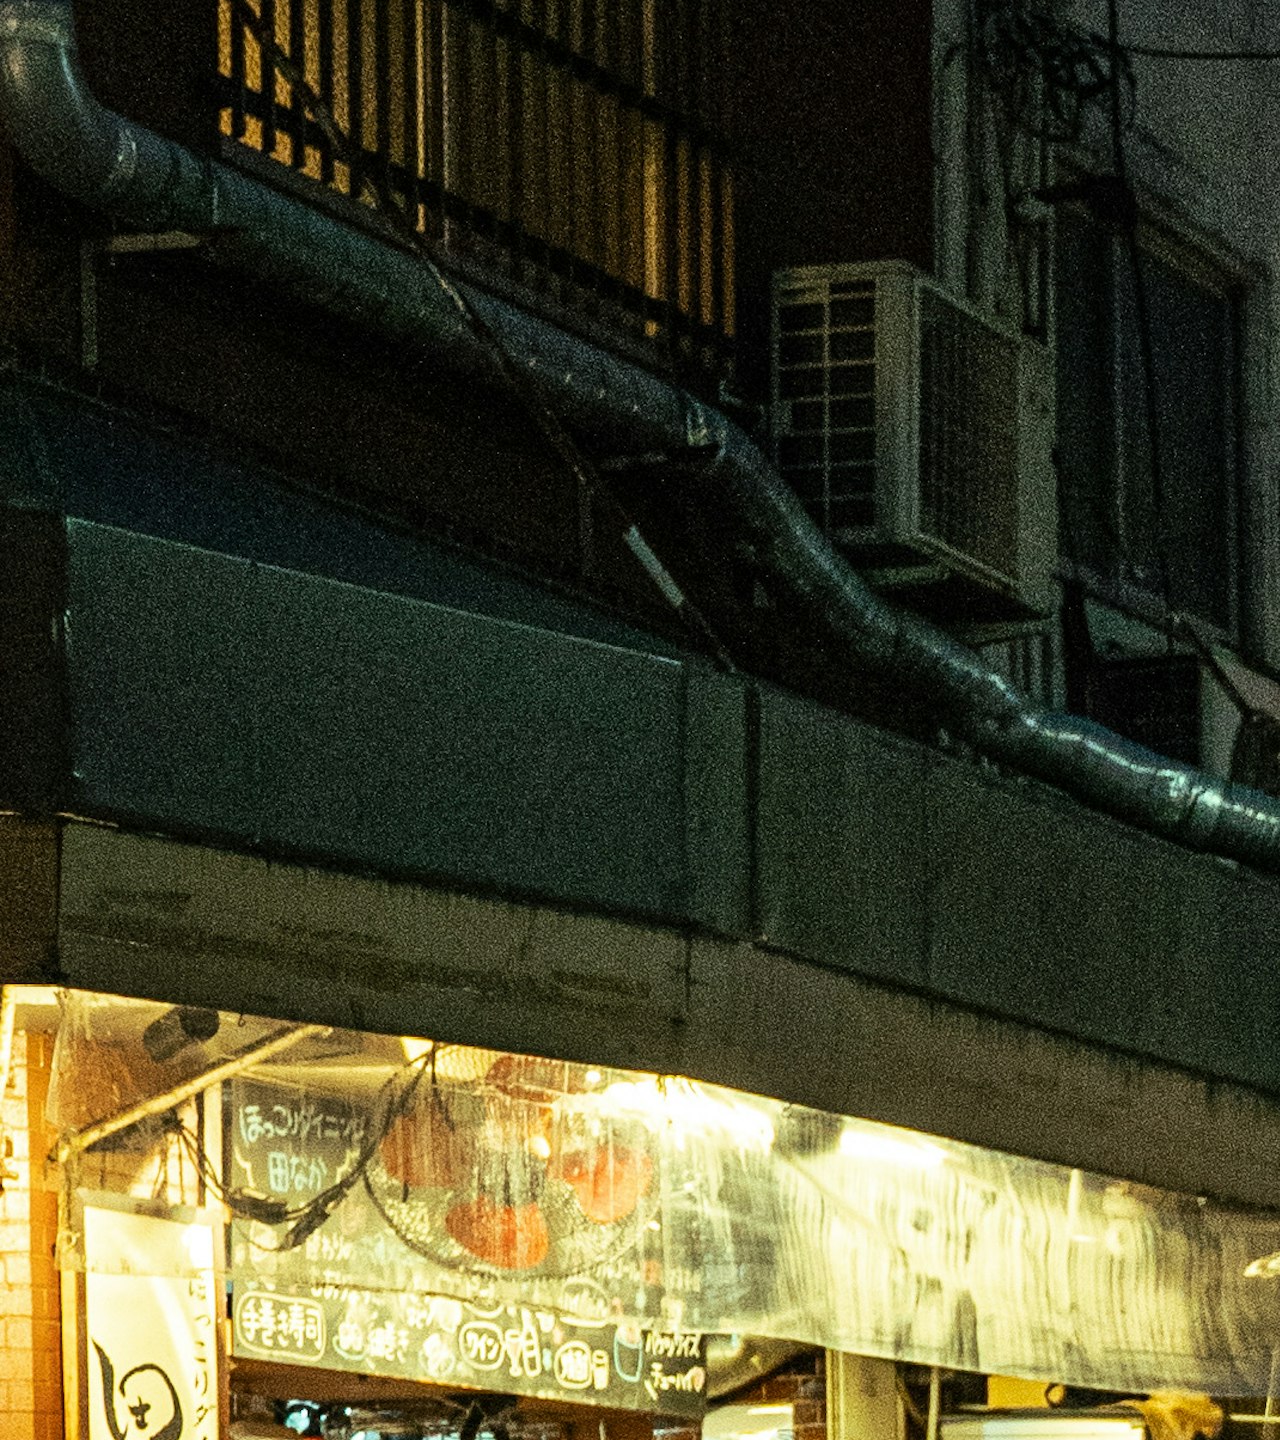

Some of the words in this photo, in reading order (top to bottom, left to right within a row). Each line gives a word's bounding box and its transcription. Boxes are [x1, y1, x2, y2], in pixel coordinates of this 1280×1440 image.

[267, 1151, 327, 1192] 田なか
[241, 1297, 323, 1351] 手巻き寿司
[466, 1330, 499, 1361] ワイン
